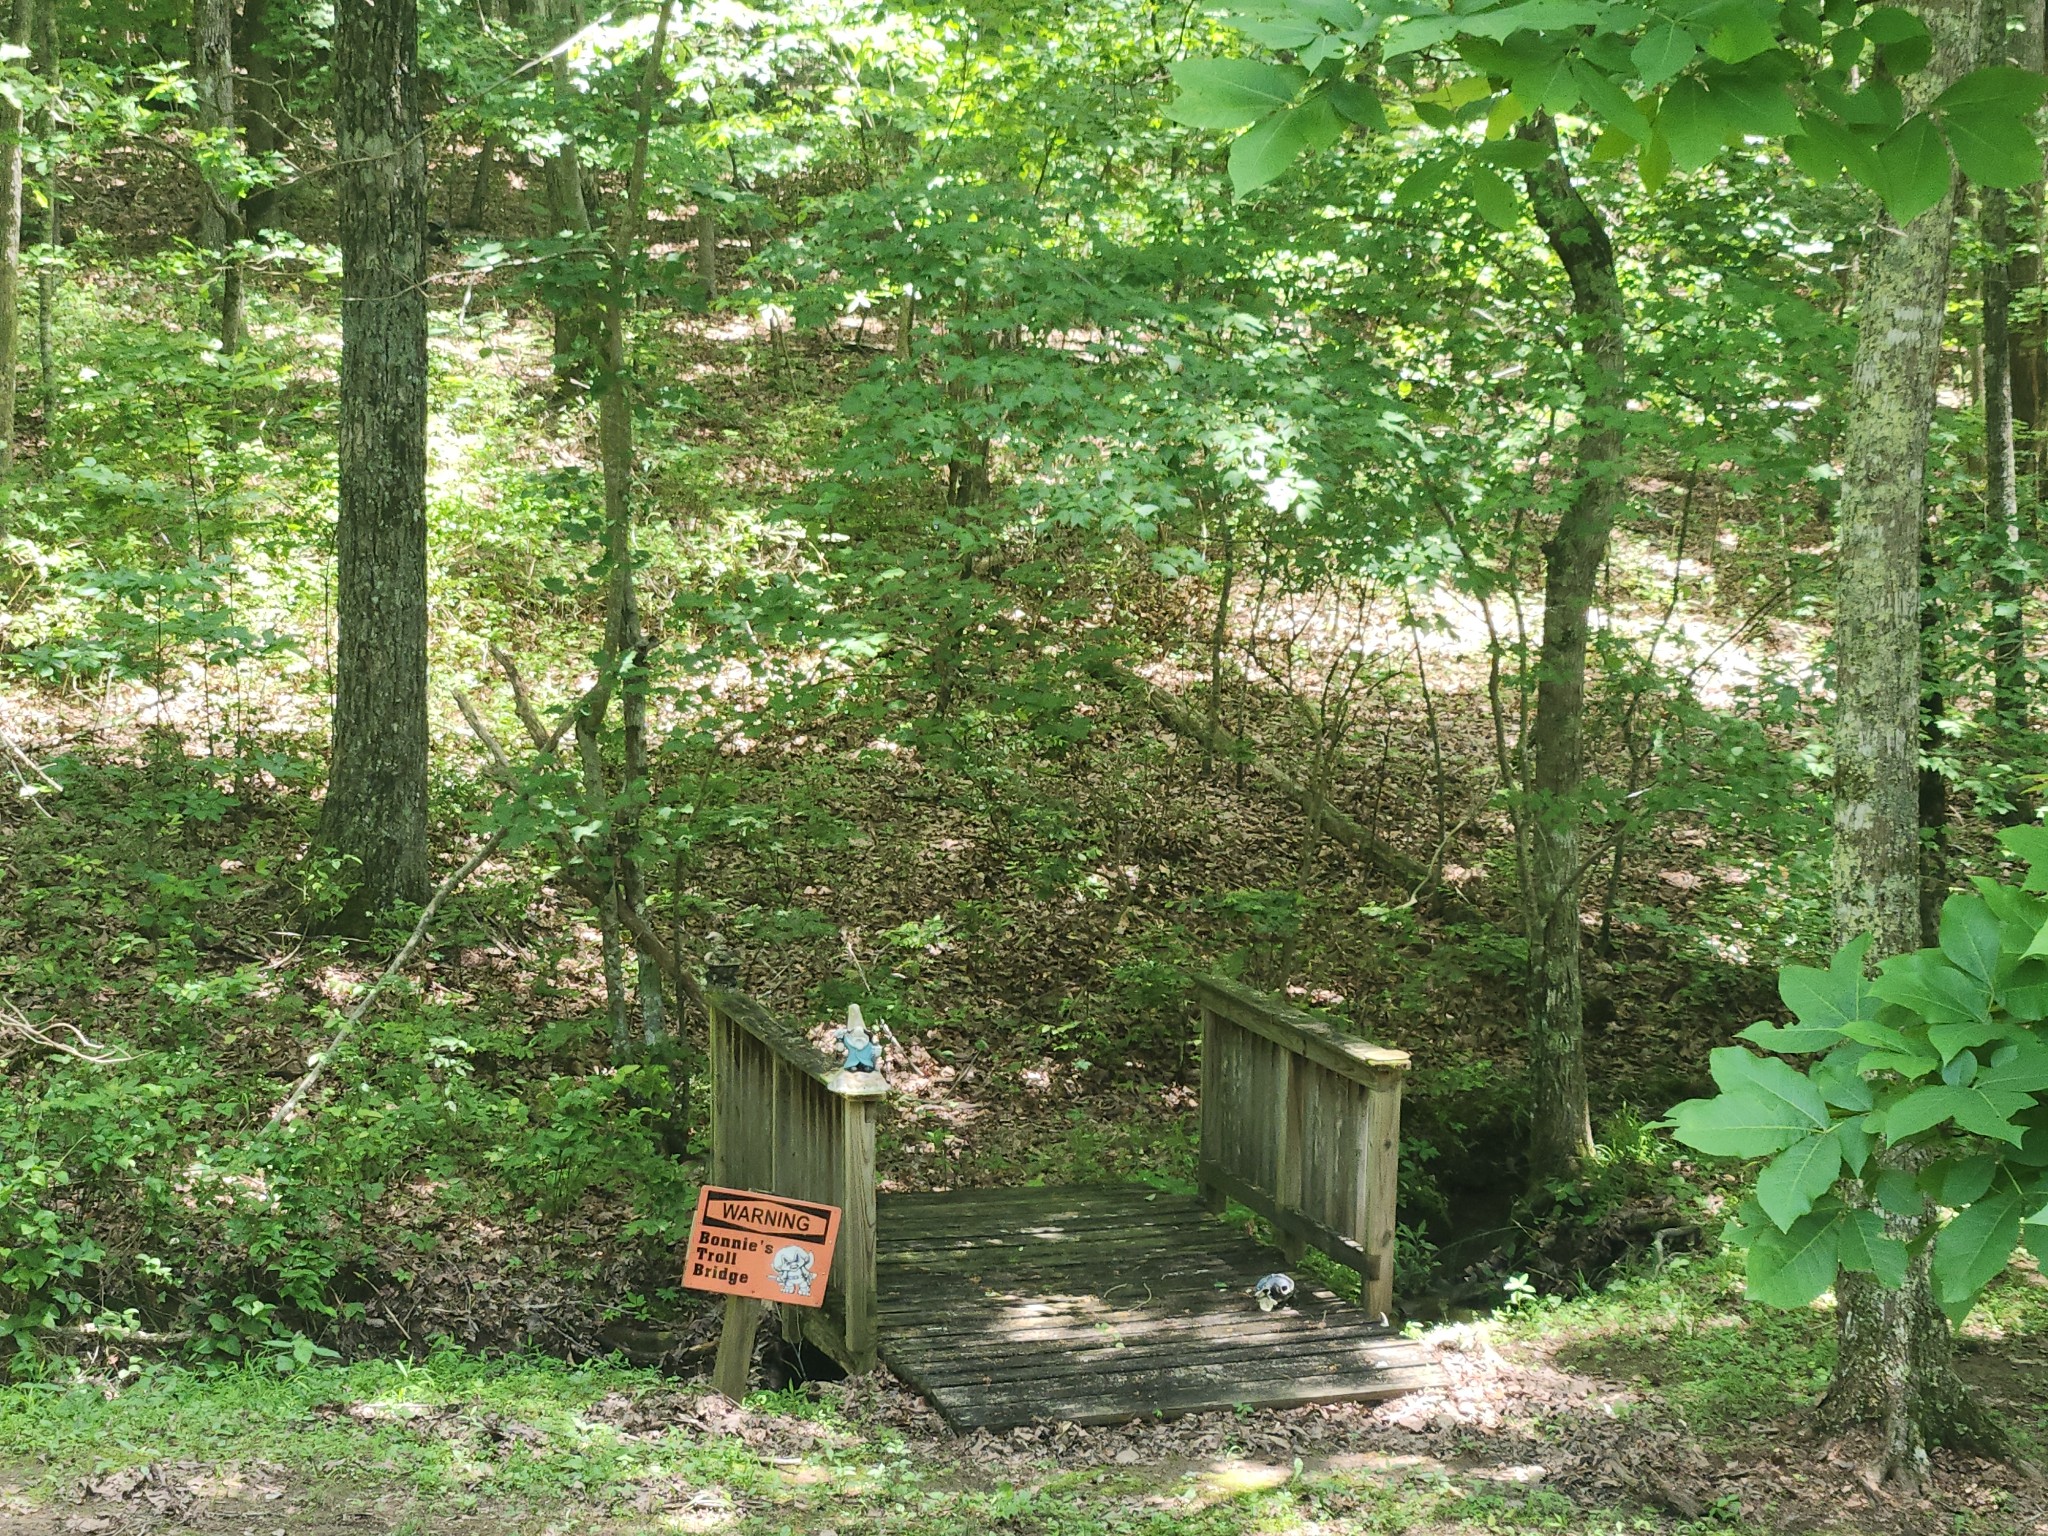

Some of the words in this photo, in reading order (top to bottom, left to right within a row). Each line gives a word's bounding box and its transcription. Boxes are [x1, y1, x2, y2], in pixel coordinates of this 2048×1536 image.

[723, 1202, 810, 1232] WARNING
[698, 1231, 774, 1254] Bonnie's
[696, 1247, 737, 1265] Troll
[692, 1263, 749, 1286] Bridge
